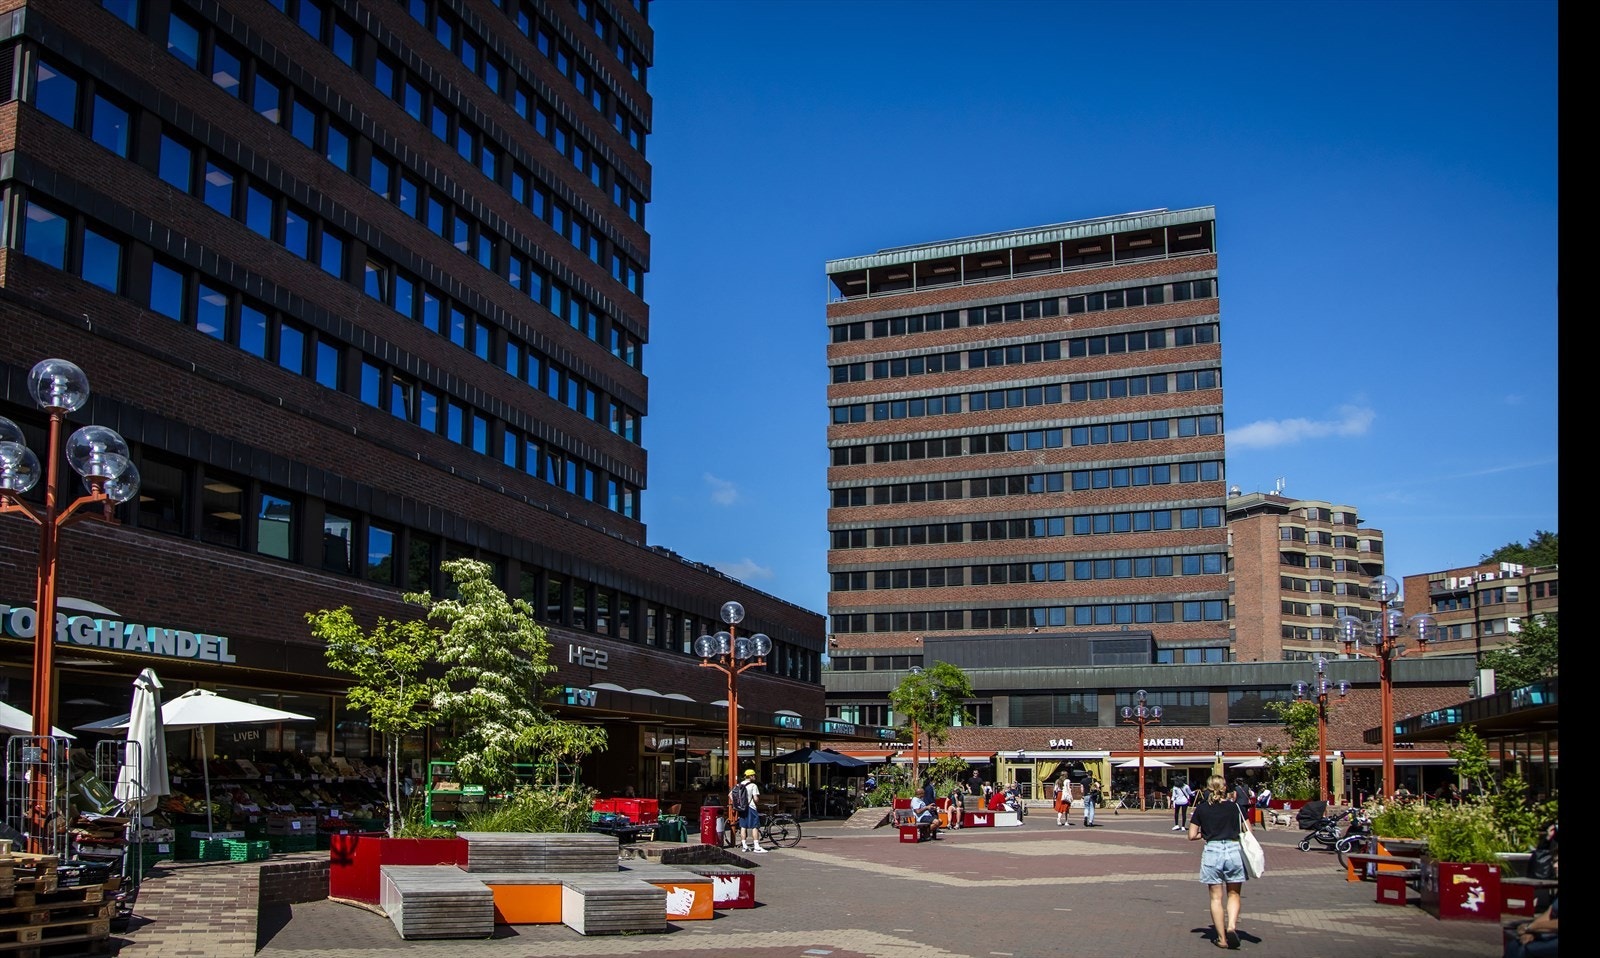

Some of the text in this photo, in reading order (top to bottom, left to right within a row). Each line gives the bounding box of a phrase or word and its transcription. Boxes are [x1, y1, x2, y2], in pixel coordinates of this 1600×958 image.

[568, 644, 608, 671] H22
[1049, 738, 1073, 747] BAR
[1142, 738, 1184, 747] BAKERI
